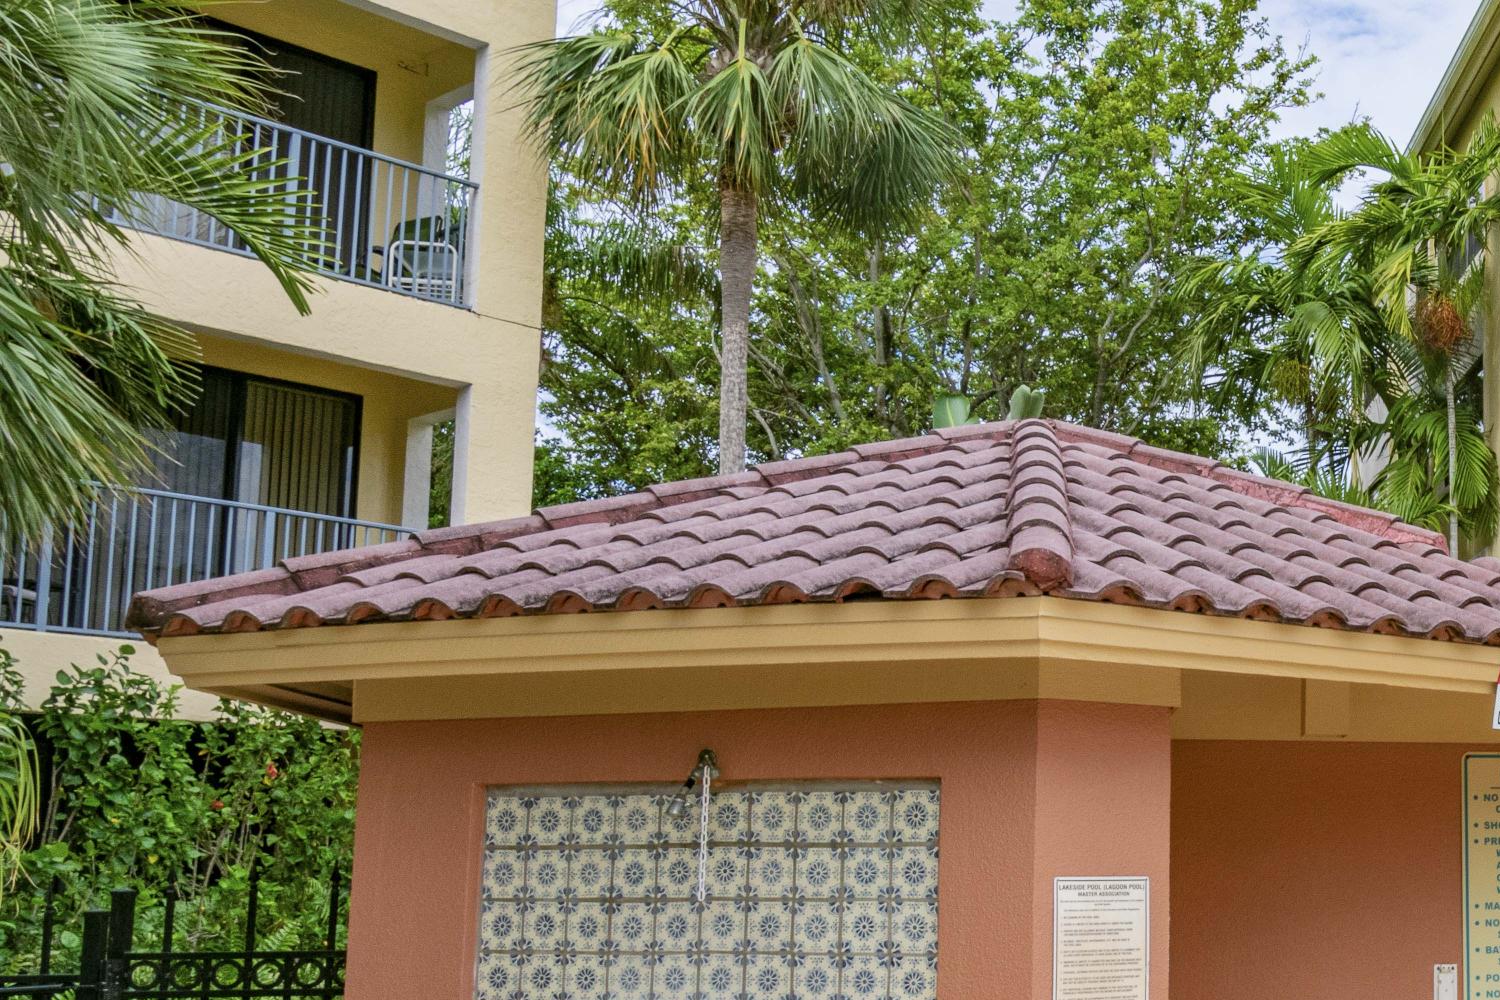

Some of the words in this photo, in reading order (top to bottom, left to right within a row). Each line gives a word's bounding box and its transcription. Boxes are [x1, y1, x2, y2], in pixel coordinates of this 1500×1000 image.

[1483, 794, 1498, 802] NO
[1486, 919, 1500, 927] NO
[1486, 990, 1500, 998] NO
